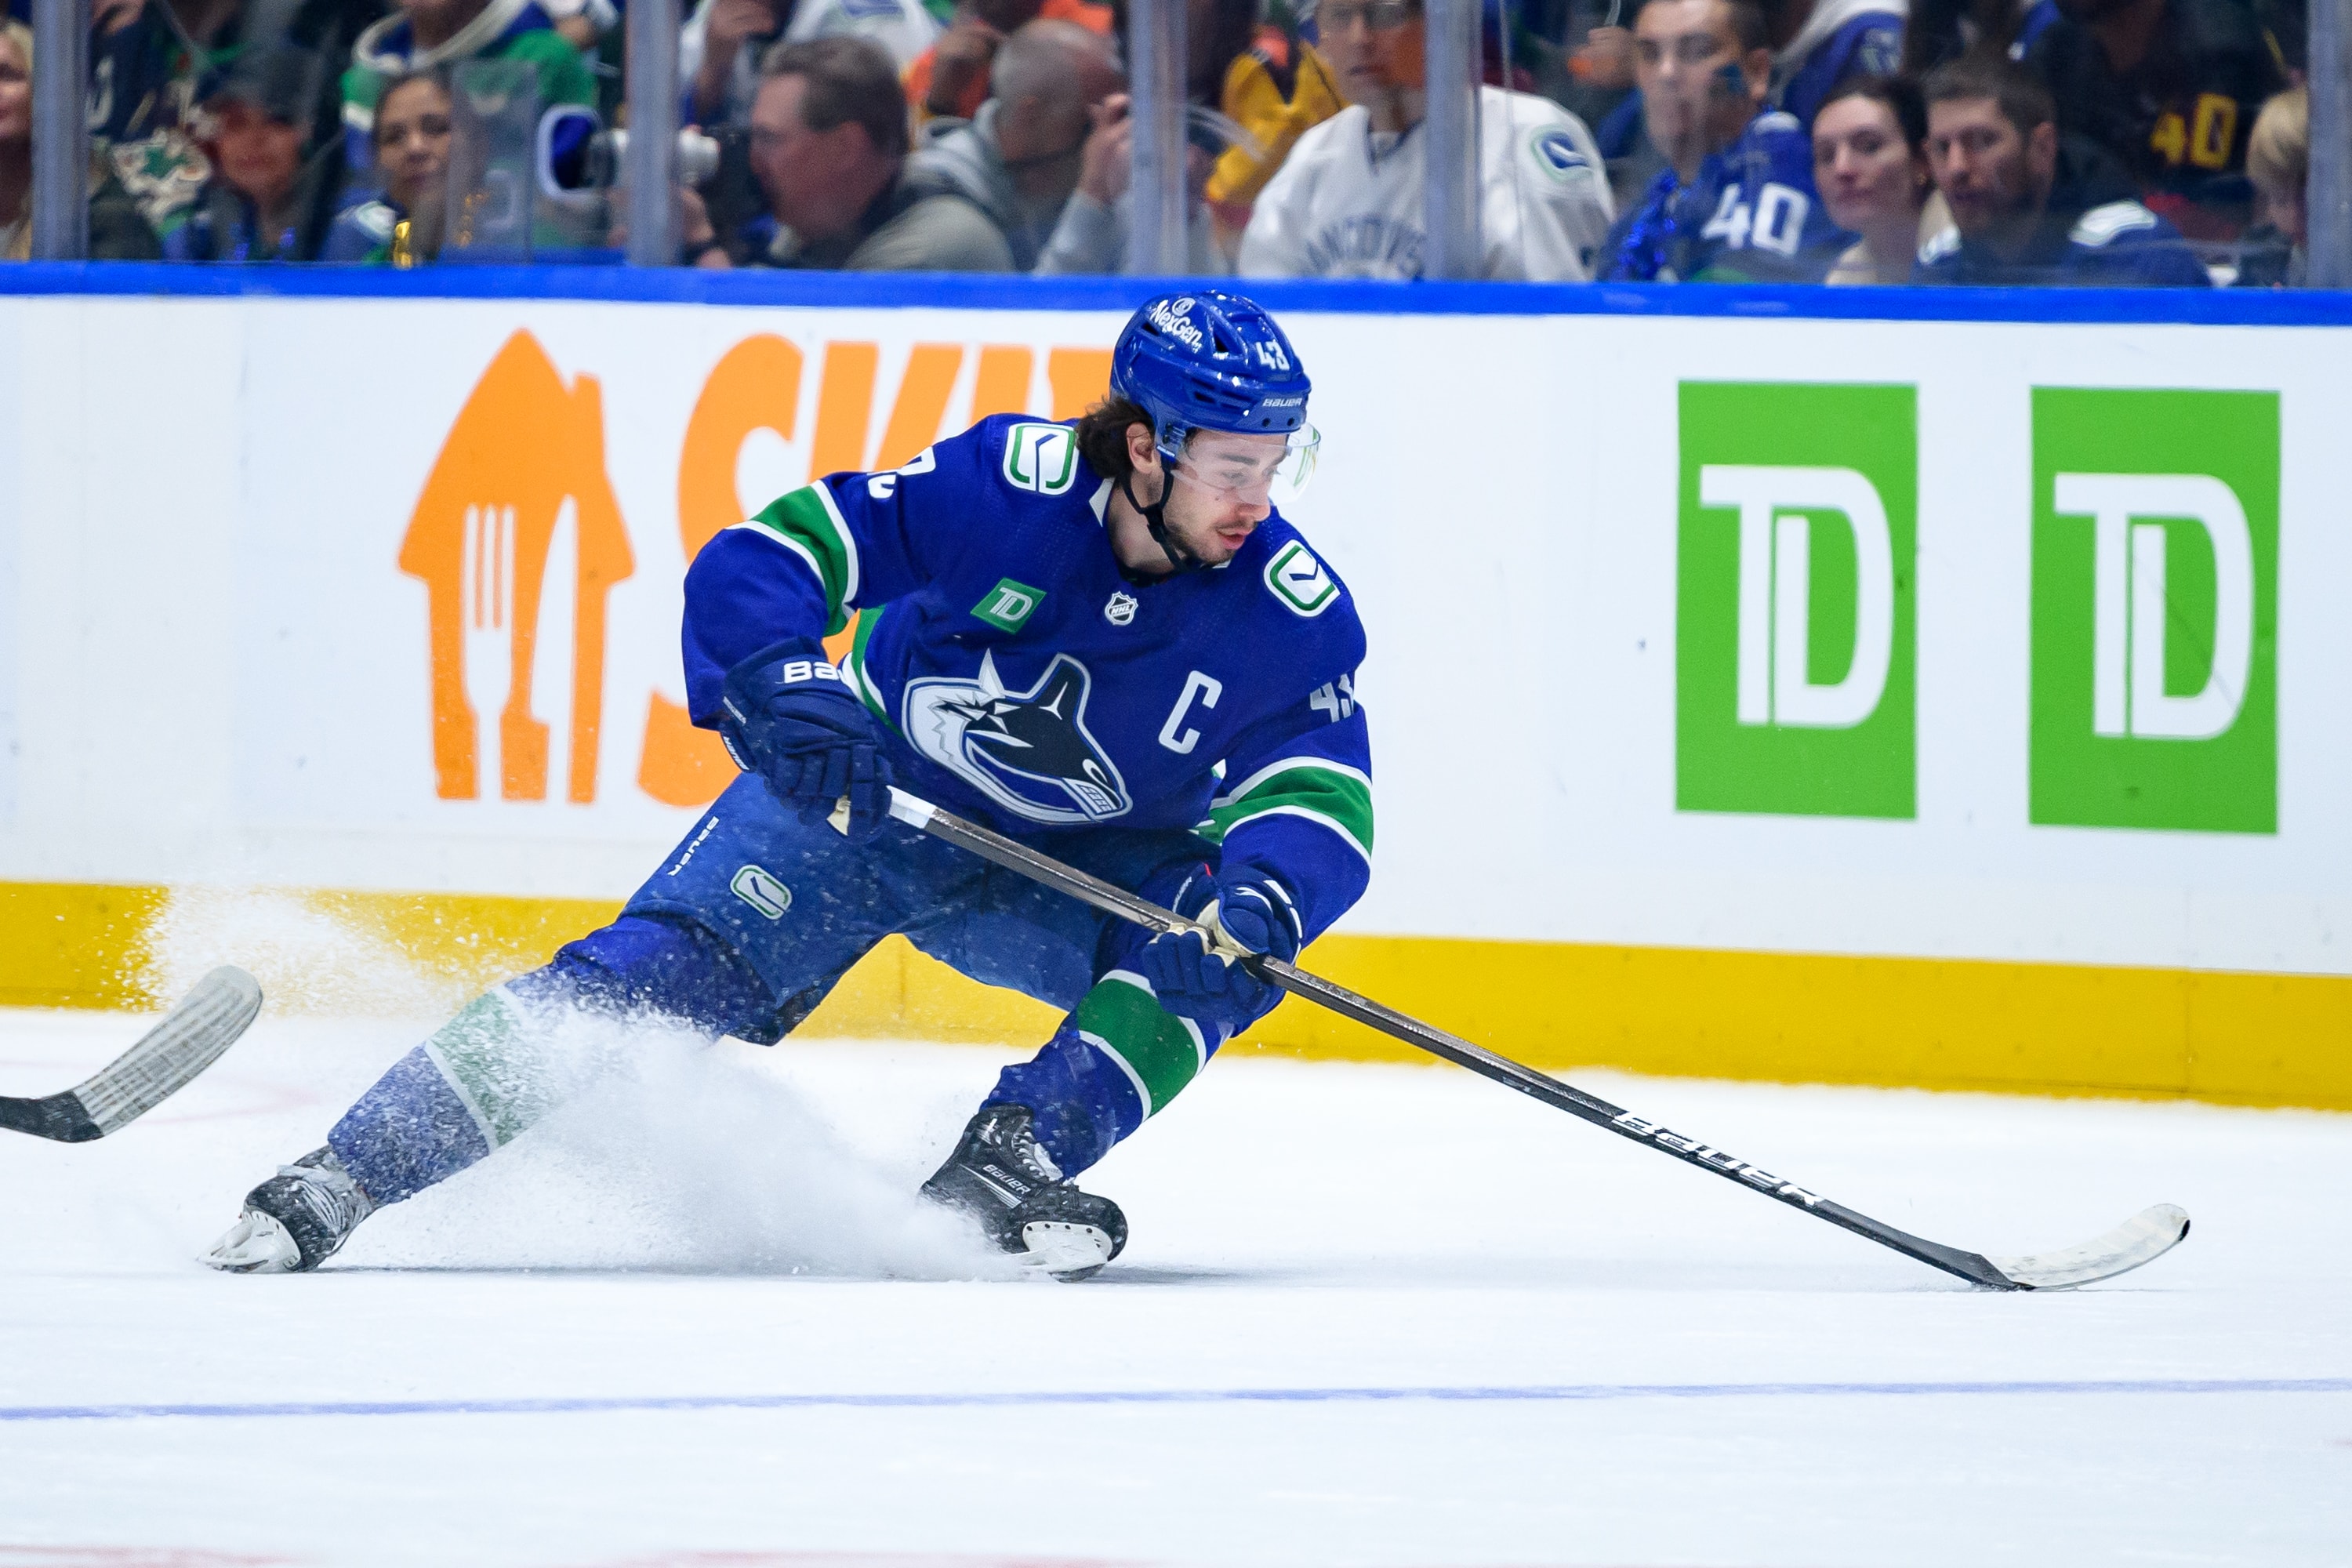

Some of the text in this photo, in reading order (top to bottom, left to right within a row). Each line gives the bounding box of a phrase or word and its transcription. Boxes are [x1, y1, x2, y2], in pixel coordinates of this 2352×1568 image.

[2151, 93, 2238, 169] 40
[1701, 182, 1810, 257] 40
[1149, 299, 1203, 345] NexGen
[1255, 340, 1290, 371] 43
[989, 586, 1033, 621] TD
[1111, 604, 1131, 615] NHL
[1700, 463, 1895, 731] TD
[2053, 472, 2256, 741] TD
[1159, 670, 1222, 754] C
